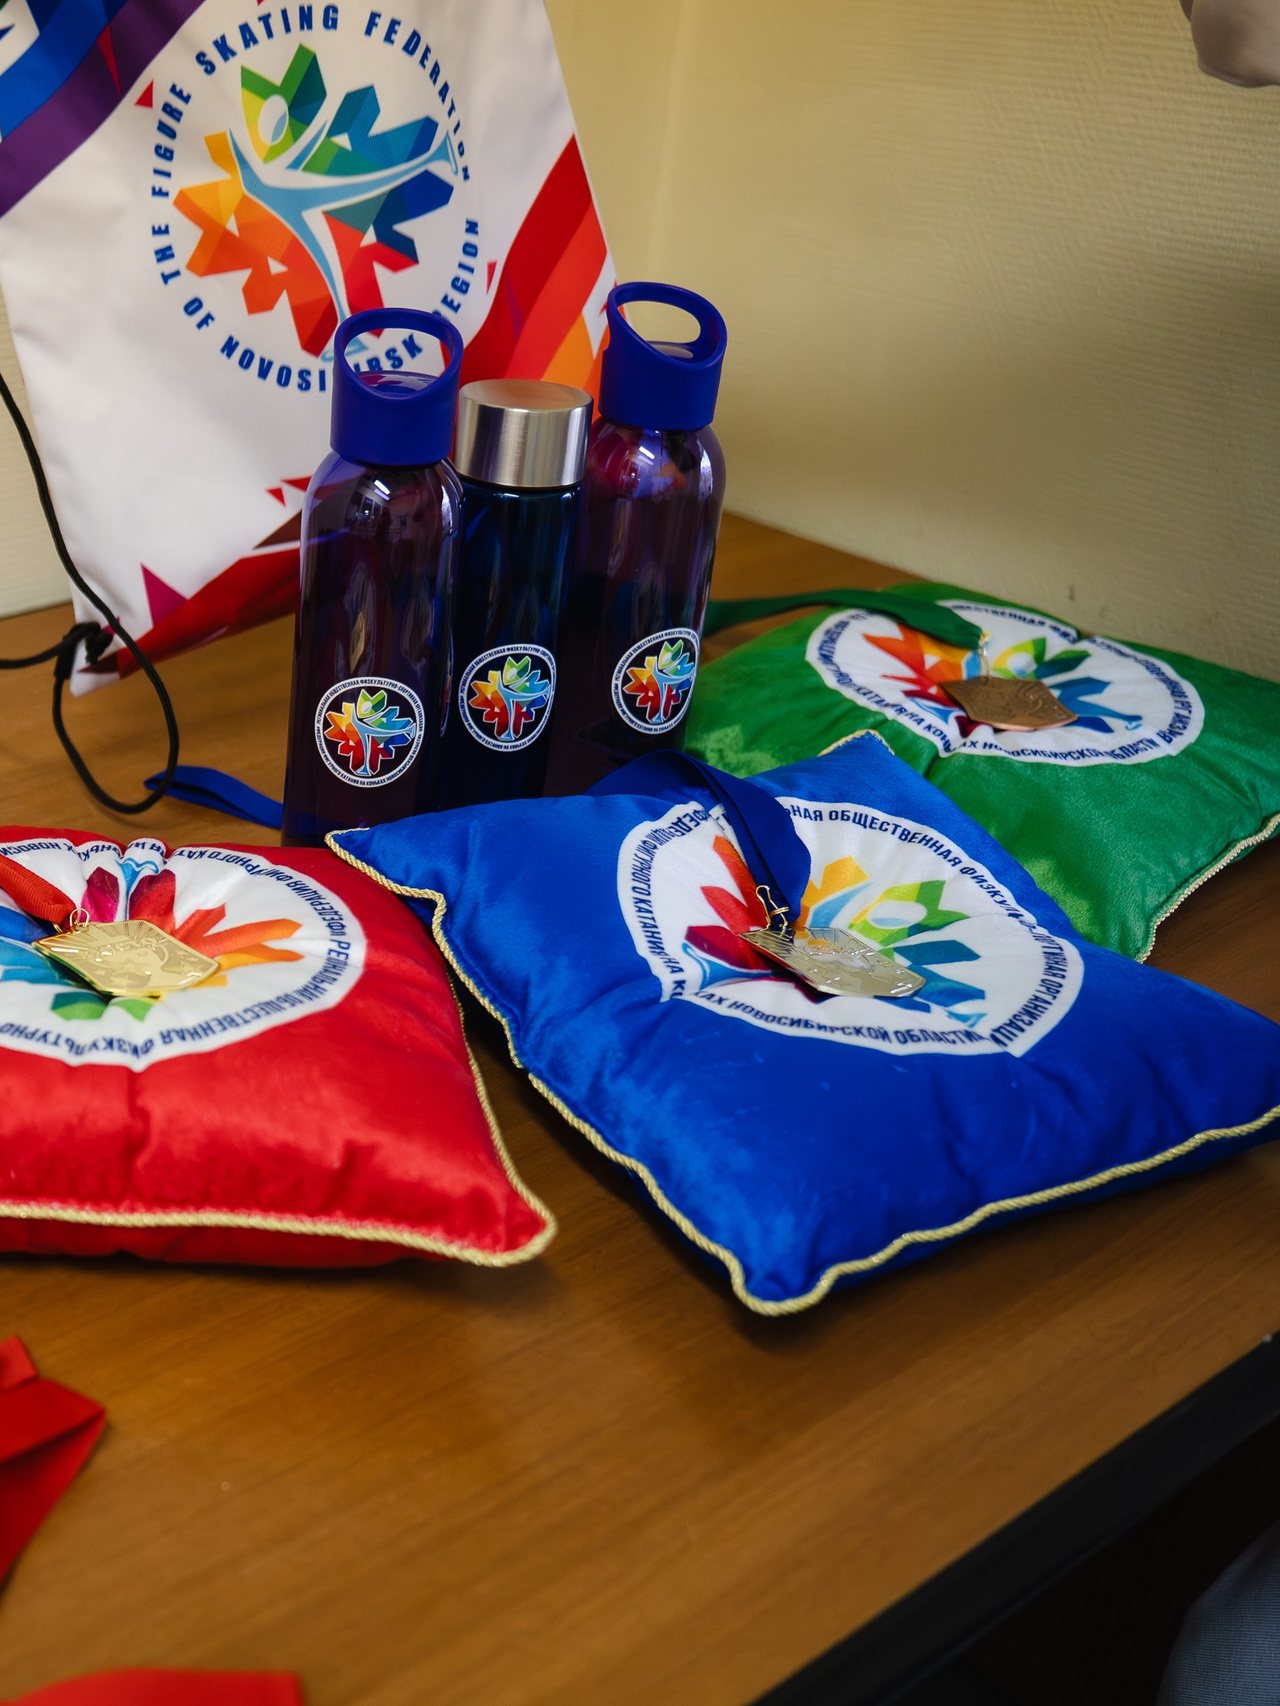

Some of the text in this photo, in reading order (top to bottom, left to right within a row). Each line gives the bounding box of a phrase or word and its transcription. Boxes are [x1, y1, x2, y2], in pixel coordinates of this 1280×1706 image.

[151, 4, 471, 286] THE FIGURE SKATING FEDERATION
[183, 297, 213, 331] OF
[432, 218, 479, 321] EGION
[828, 808, 963, 868] ОБЩЕСТВЕННАЯ
[631, 840, 659, 896] ФИГУРНОГО
[632, 897, 670, 957] КАТАНИЯ
[659, 956, 680, 974] НА
[159, 991, 302, 1045] ОБЩЕСТВЕННАЯ
[729, 1000, 892, 1043] НОВОСИБИРСКОЙ
